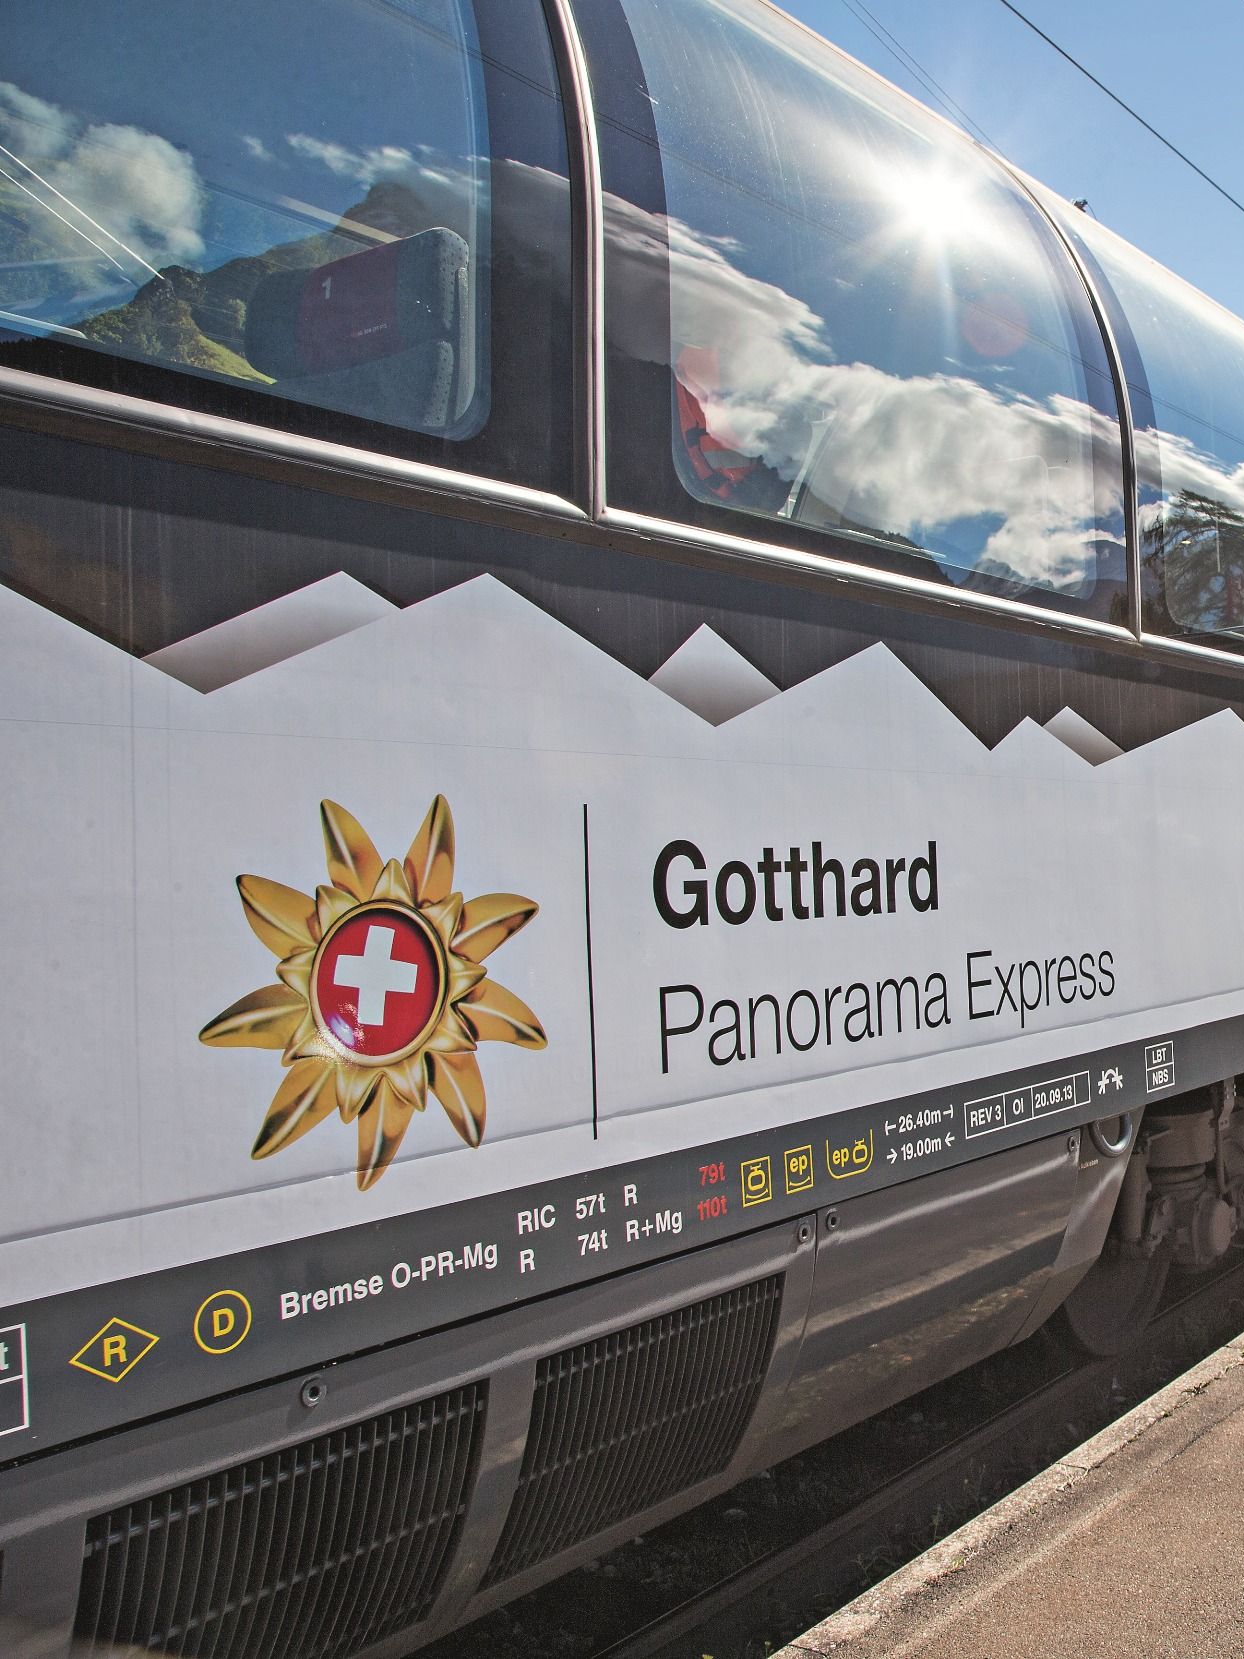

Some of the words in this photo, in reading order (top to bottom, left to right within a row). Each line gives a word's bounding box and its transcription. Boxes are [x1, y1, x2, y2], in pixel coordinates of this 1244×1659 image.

[653, 839, 939, 929] Gotthard
[658, 971, 951, 1074] Panorama
[966, 948, 1116, 1029] Express
[1152, 1047, 1167, 1064] LBT
[1152, 1068, 1169, 1086] NBS
[898, 1108, 942, 1134] 26.40m
[970, 1105, 993, 1128] REV
[994, 1104, 1002, 1121] 3
[1034, 1085, 1073, 1109] 20.09.13
[789, 1155, 808, 1175] ep
[832, 1146, 850, 1168] ep
[900, 1137, 942, 1161] 19.00m
[517, 1204, 556, 1236] RIC
[575, 1193, 606, 1220] 57t
[623, 1183, 638, 1207] R
[699, 1161, 726, 1186] 79t
[520, 1248, 536, 1274] R
[577, 1229, 608, 1256] 74t
[625, 1209, 683, 1243] R+Mg
[697, 1195, 727, 1221] 110t
[280, 1274, 384, 1320] Bremse
[391, 1242, 498, 1289] O-PR-Mg
[213, 1307, 235, 1338] D
[103, 1334, 128, 1367] R
